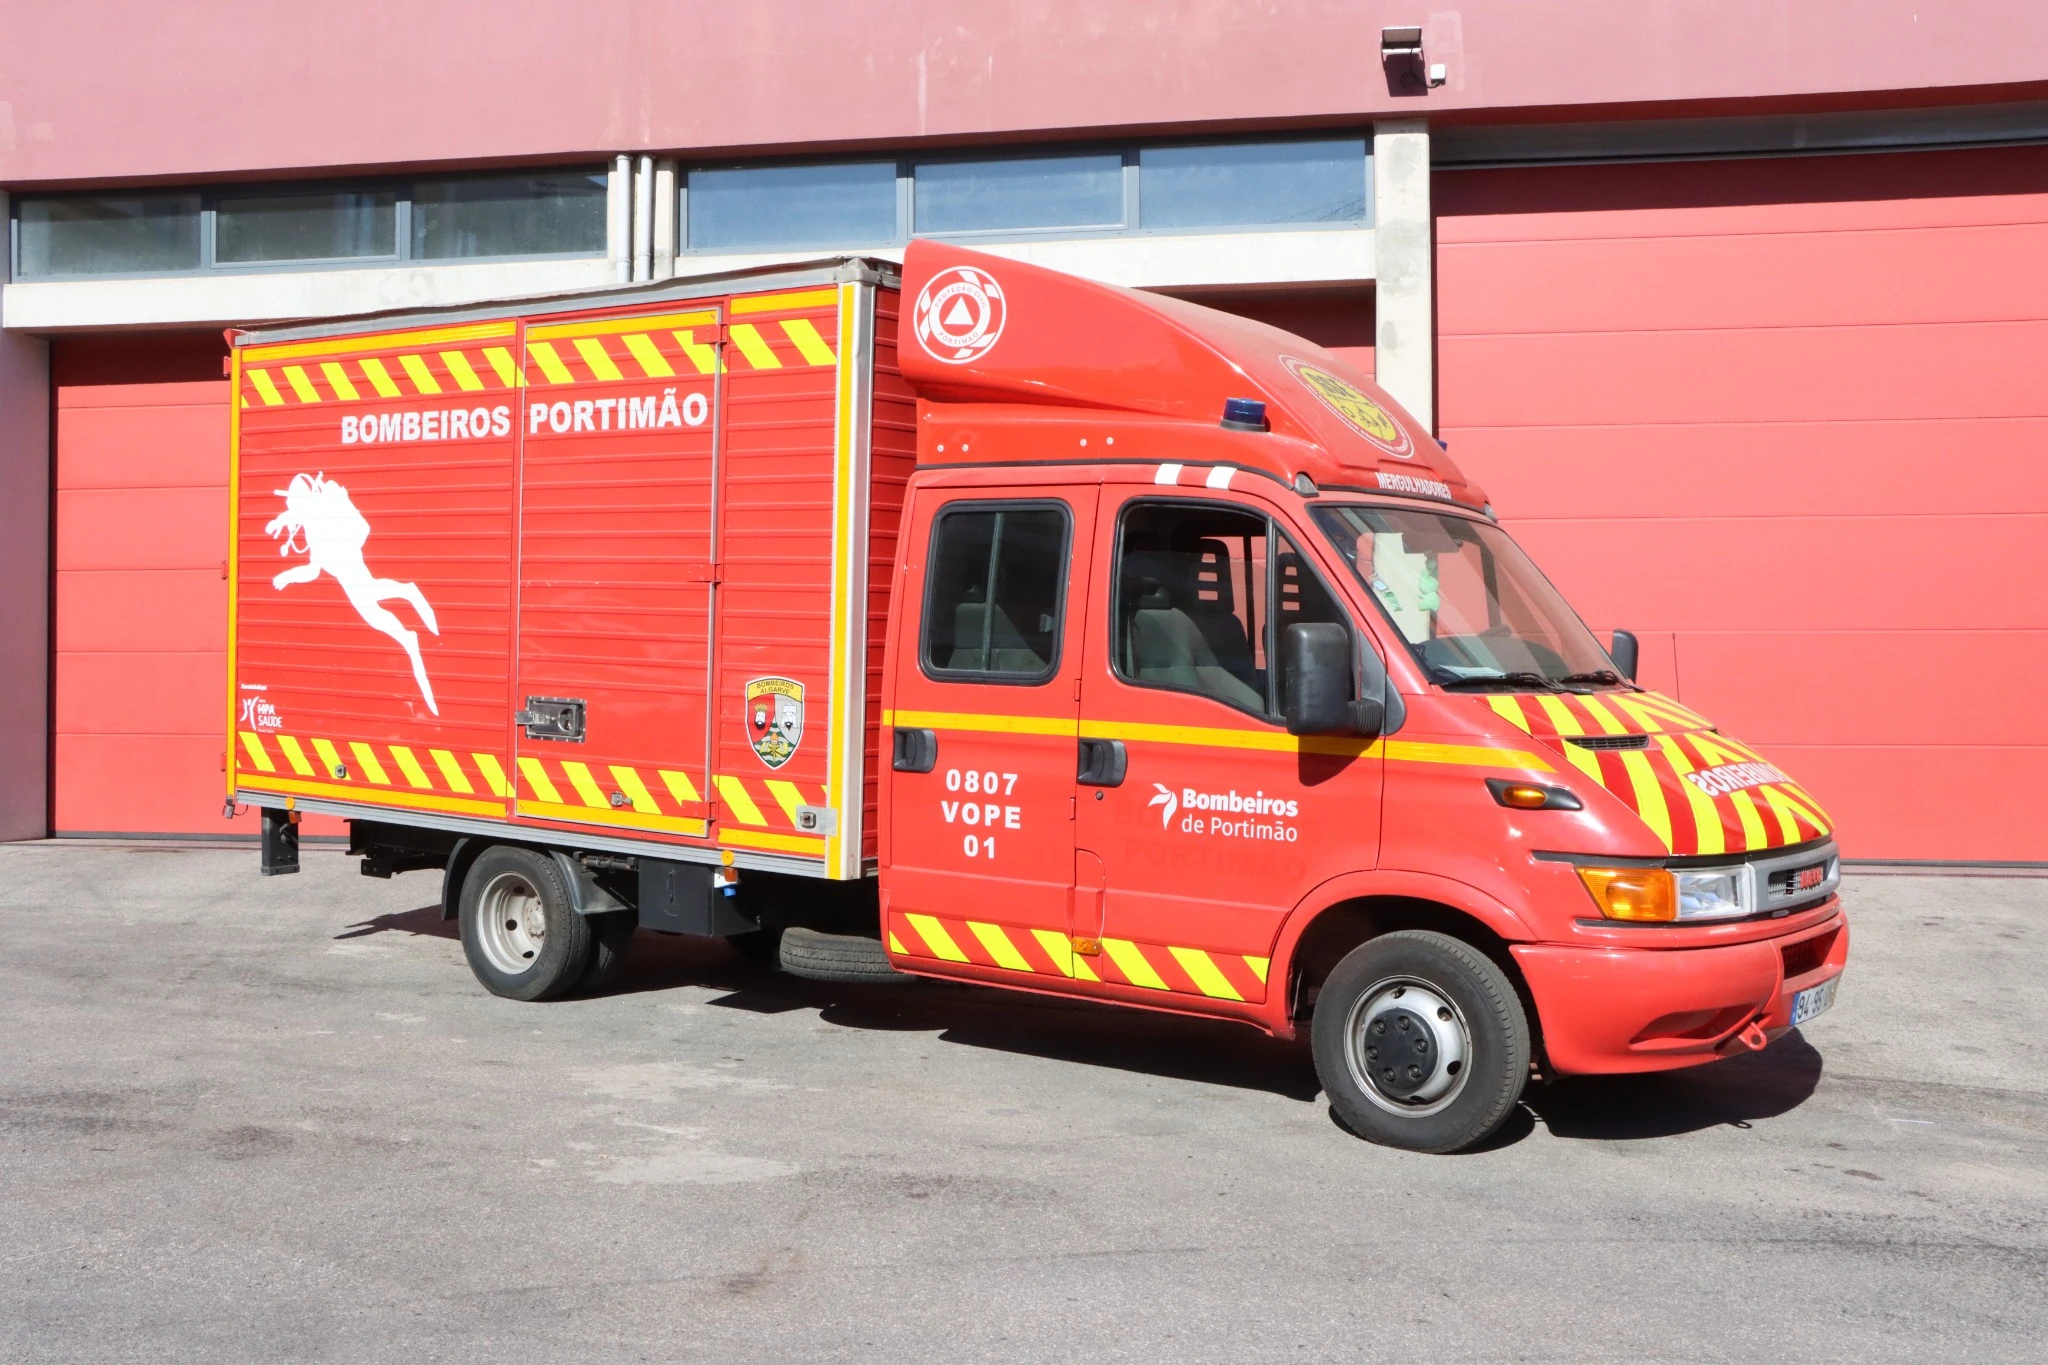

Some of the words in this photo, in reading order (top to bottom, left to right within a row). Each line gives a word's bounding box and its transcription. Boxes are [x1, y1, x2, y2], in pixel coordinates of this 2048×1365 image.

[341, 405, 511, 445] BOMBEIROS
[529, 387, 709, 434] PORTIMÃO
[1375, 471, 1452, 500] MERGULHADORES
[756, 680, 795, 690] BOMBEIROS
[760, 686, 791, 695] ALGARVE
[257, 703, 276, 716] HPA
[945, 768, 1018, 796] 0807
[940, 800, 1021, 829] VOPE
[1182, 788, 1298, 817] Bombeiros
[1181, 814, 1204, 834] de
[1211, 816, 1298, 842] Portimão
[963, 834, 995, 859] 01
